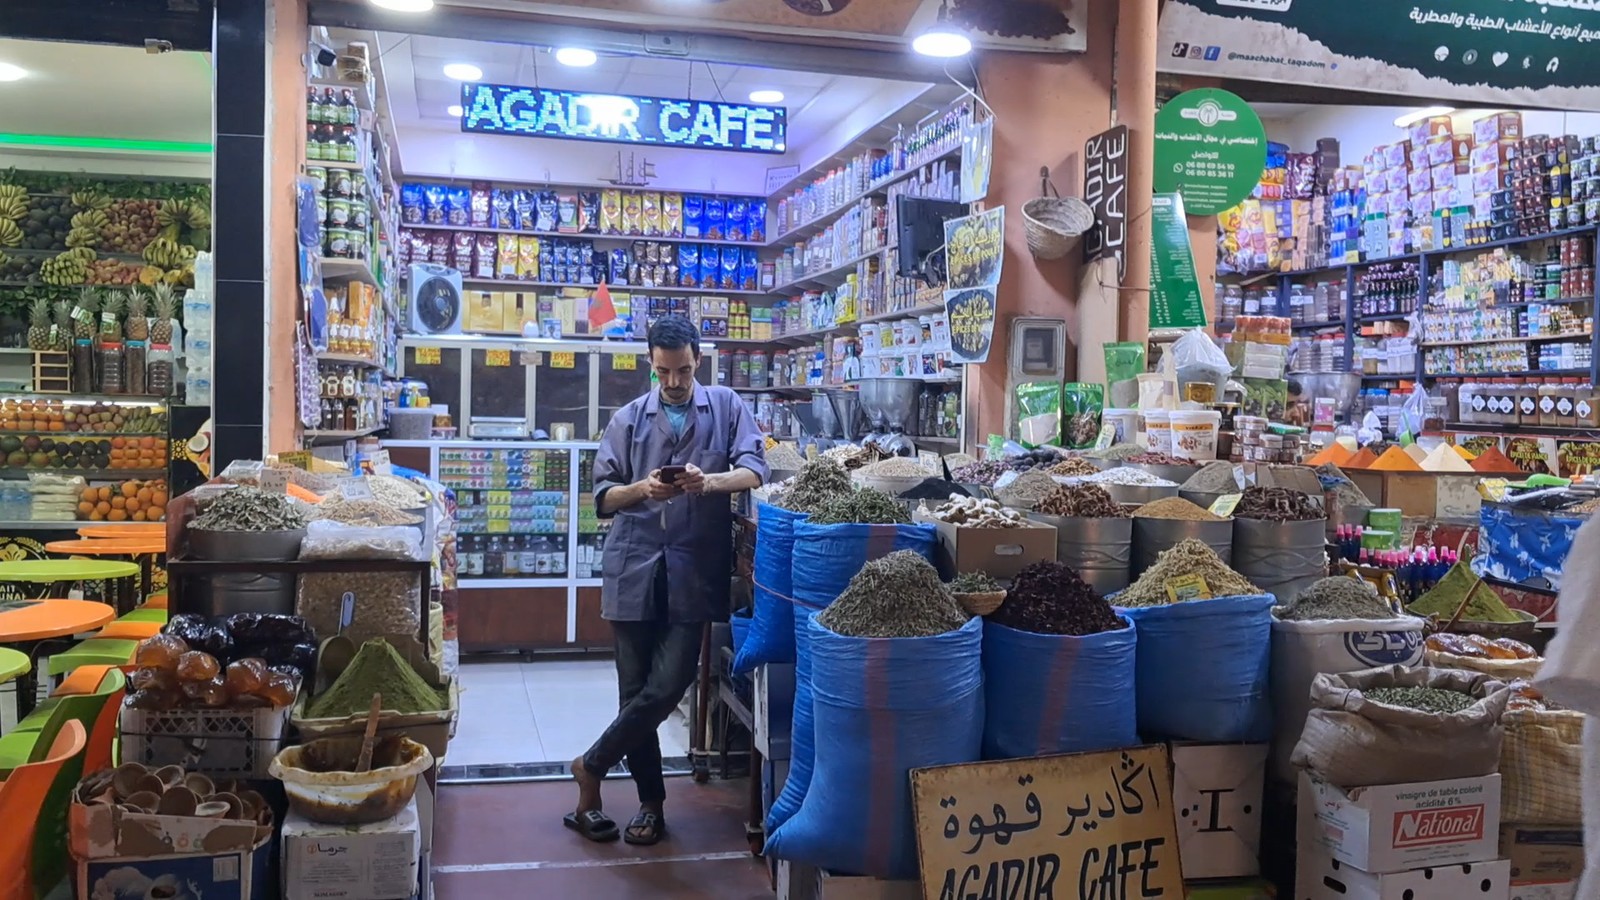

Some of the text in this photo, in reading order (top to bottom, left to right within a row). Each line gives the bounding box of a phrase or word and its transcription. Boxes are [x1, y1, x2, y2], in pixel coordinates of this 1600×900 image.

[1409, 7, 1600, 43] ميع أنواع الأعشاب الطبية والعطرية
[467, 85, 774, 150] AGADIR CAFE
[1191, 150, 1219, 160] للتواصل
[1203, 134, 1218, 143] مجال
[1219, 135, 1227, 146] في
[1106, 133, 1125, 247] CAFE
[1395, 784, 1483, 801] vinaigre de table coloré
[1415, 798, 1446, 809] acidité
[939, 773, 1043, 855] قهوة
[1396, 806, 1482, 845] National
[938, 837, 1166, 900] AGADIR CAFE
